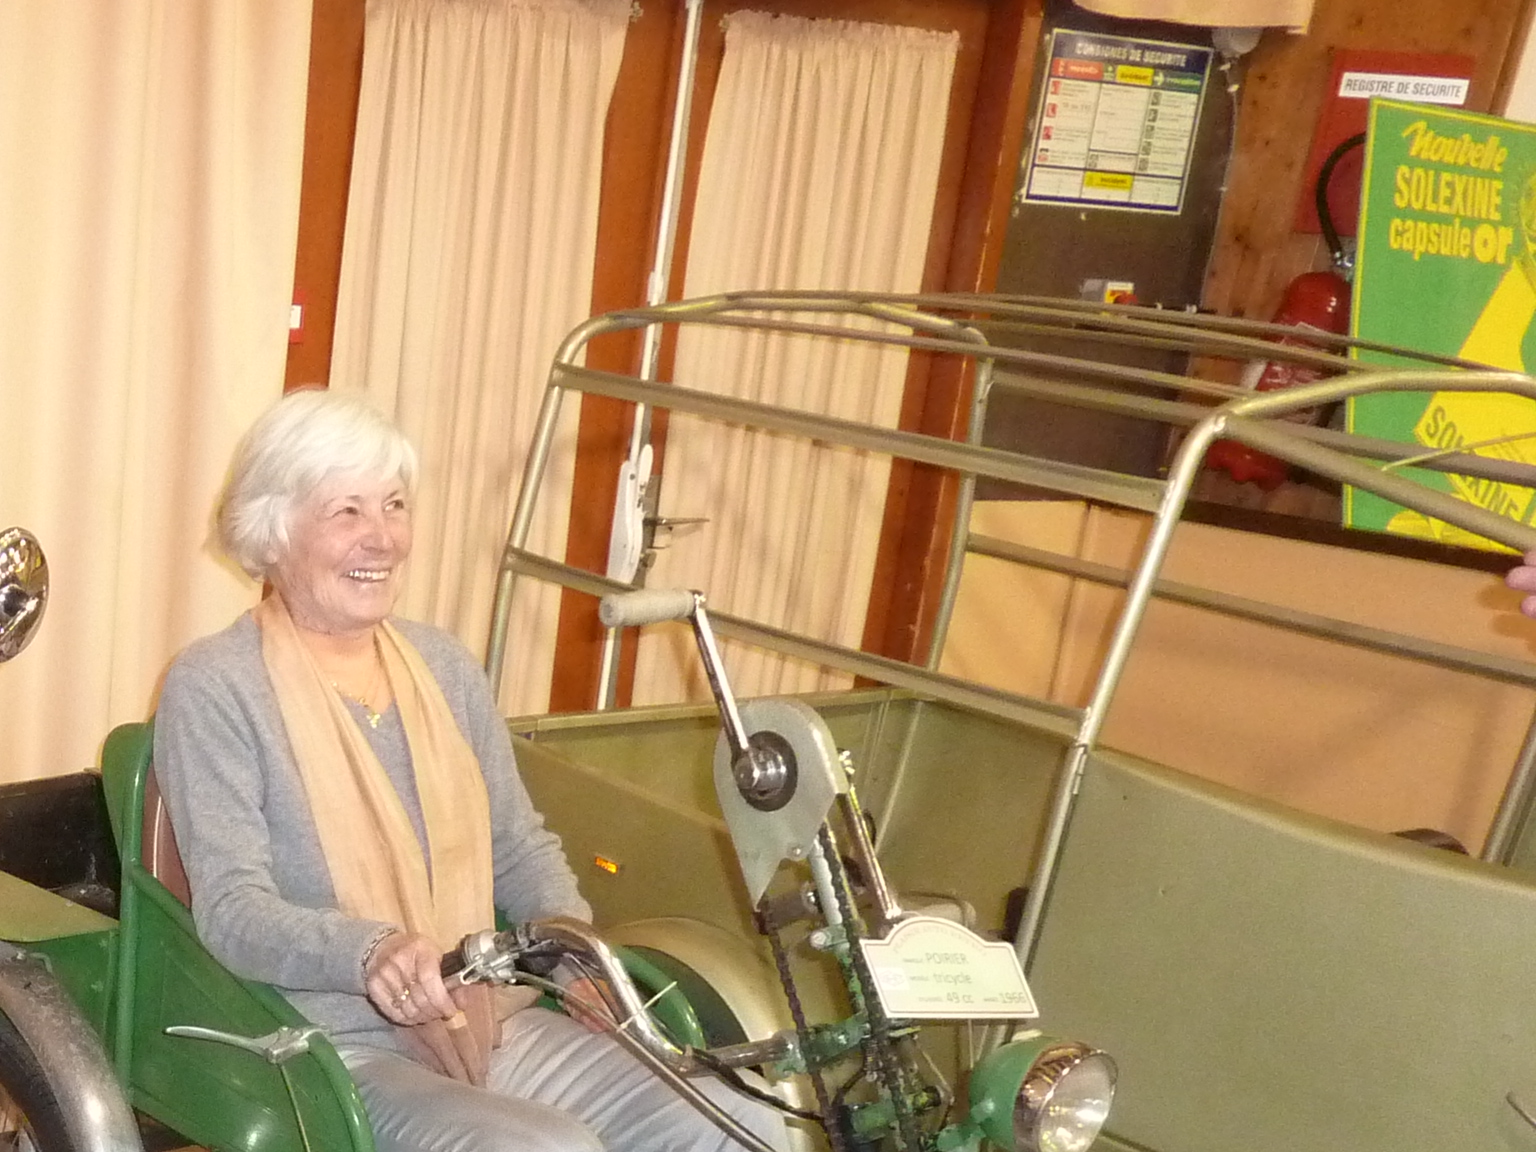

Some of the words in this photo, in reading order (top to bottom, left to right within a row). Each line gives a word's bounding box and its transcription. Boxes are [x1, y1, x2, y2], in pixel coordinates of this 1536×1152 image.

[1128, 48, 1143, 62] DE
[1344, 78, 1395, 93] REGISTRE
[1396, 81, 1411, 95] DE
[1411, 82, 1463, 98] SECURITE
[1401, 120, 1509, 172] Nouvelle
[1393, 165, 1504, 220] SOLEXINE
[925, 952, 969, 965] POIRIER
[932, 971, 973, 986] tricycle
